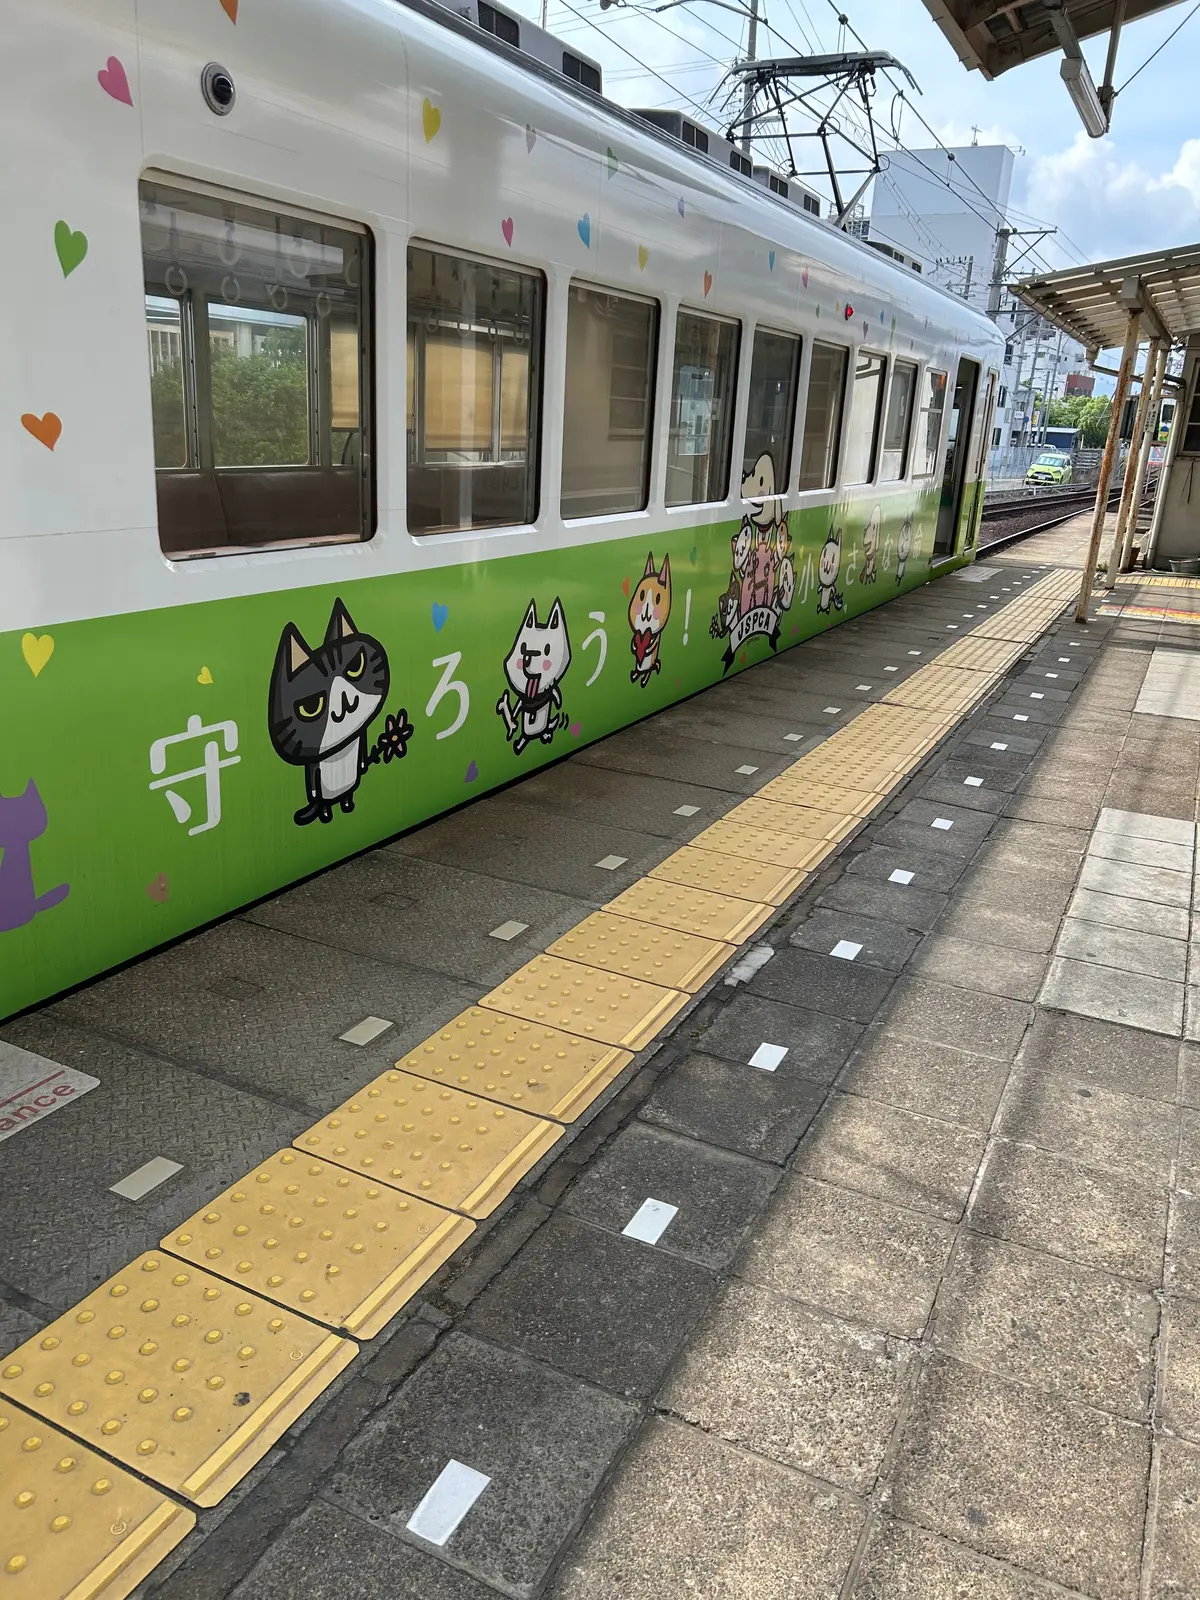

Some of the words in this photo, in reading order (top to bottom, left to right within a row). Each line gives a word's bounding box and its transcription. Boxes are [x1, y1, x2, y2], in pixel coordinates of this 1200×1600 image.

[738, 611, 771, 641] JSPCA
[149, 714, 242, 836] 守
[425, 651, 470, 740] ろ
[581, 611, 608, 687] う
